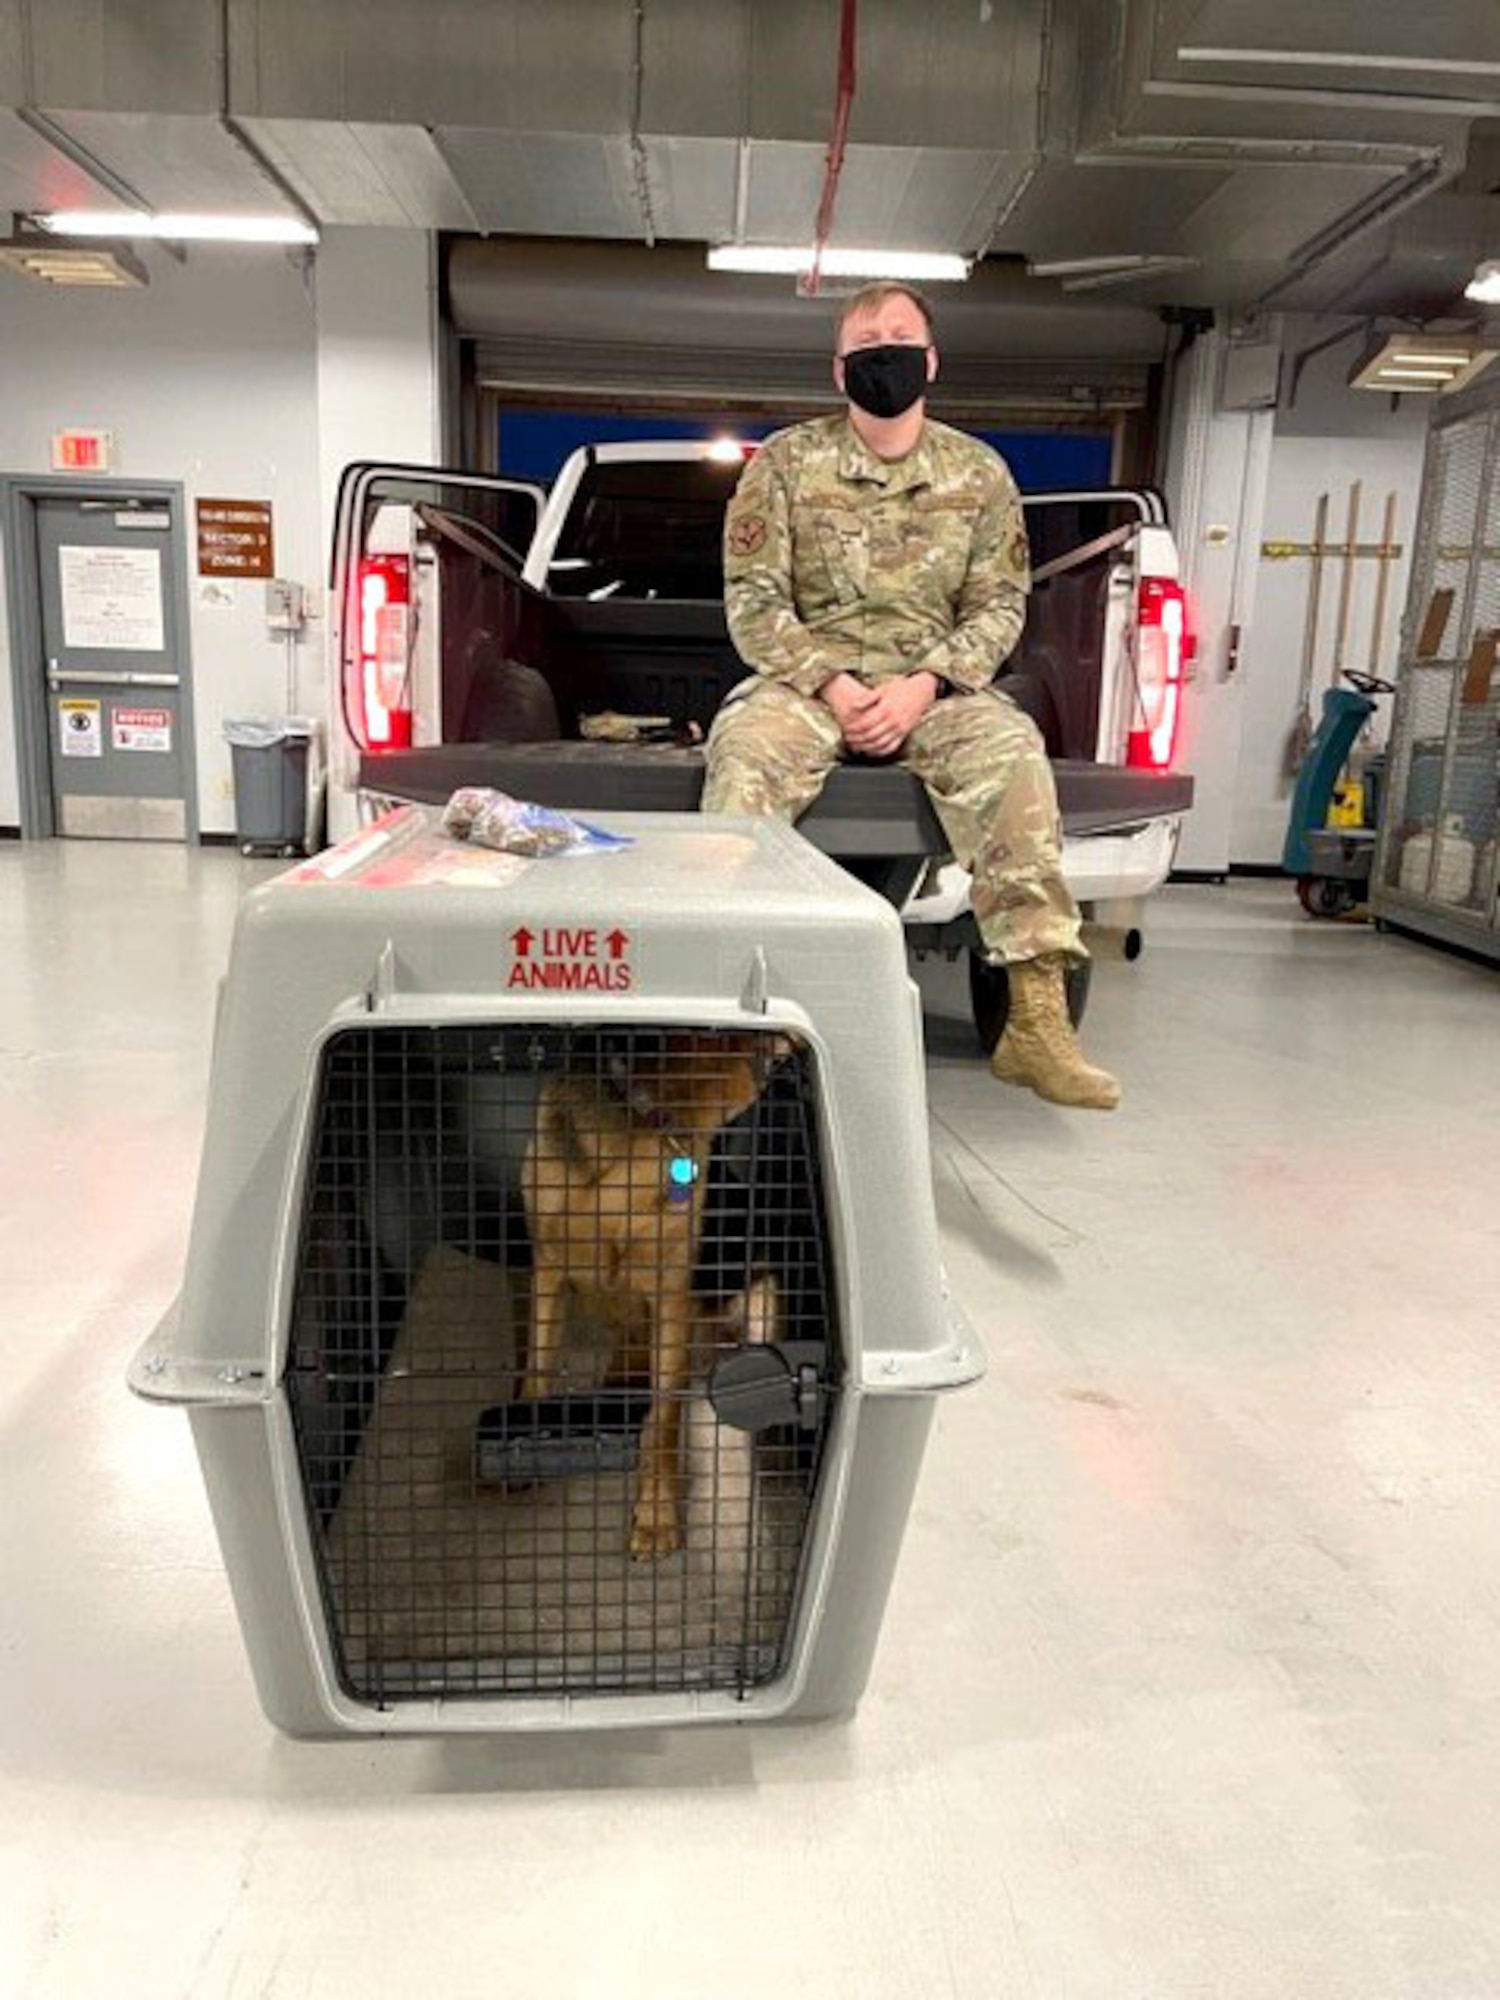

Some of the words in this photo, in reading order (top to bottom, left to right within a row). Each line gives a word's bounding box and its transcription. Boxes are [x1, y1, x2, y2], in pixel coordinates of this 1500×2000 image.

[62, 437, 98, 466] EXIT
[117, 712, 165, 727] NOTICE
[543, 928, 597, 957] LIVE
[507, 962, 631, 990] ANIMALS
